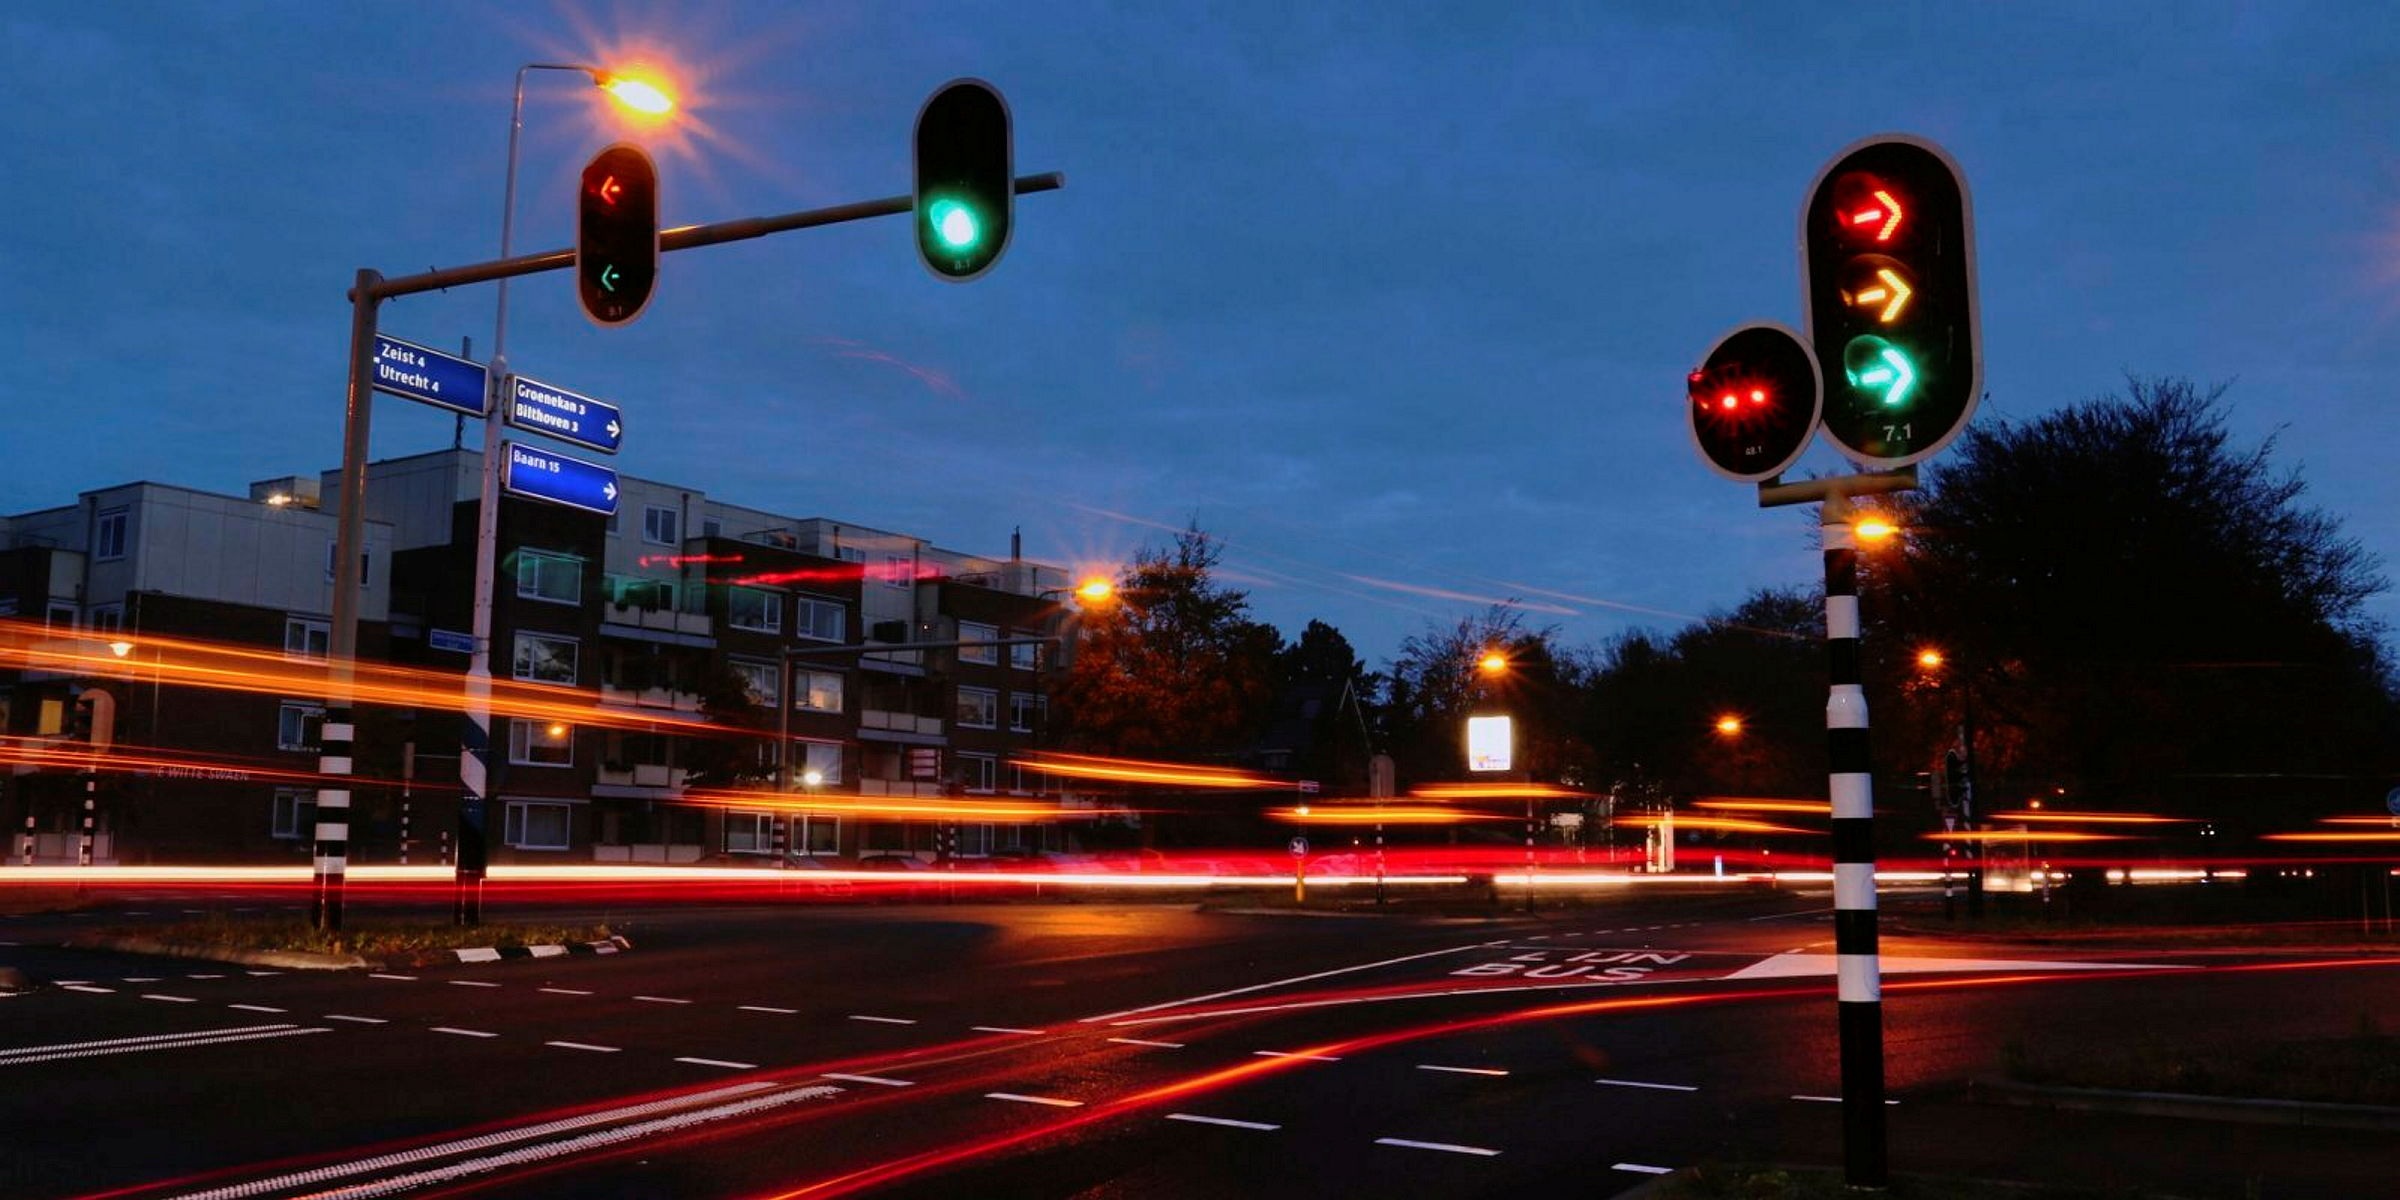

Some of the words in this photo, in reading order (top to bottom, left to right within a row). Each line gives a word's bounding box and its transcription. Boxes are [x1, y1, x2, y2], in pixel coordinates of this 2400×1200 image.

[381, 343, 415, 365] Zeist
[417, 356, 426, 368] 4
[380, 364, 429, 390] Utrecht
[431, 381, 440, 393] 4
[517, 383, 577, 414] Groenekan
[578, 404, 586, 416] 3
[515, 403, 570, 430] Bilthoven
[570, 421, 579, 433] 3
[1882, 423, 1912, 442] 7.1
[513, 450, 546, 470] Baarn
[548, 461, 561, 473] 15
[1449, 962, 1654, 981] BUS
